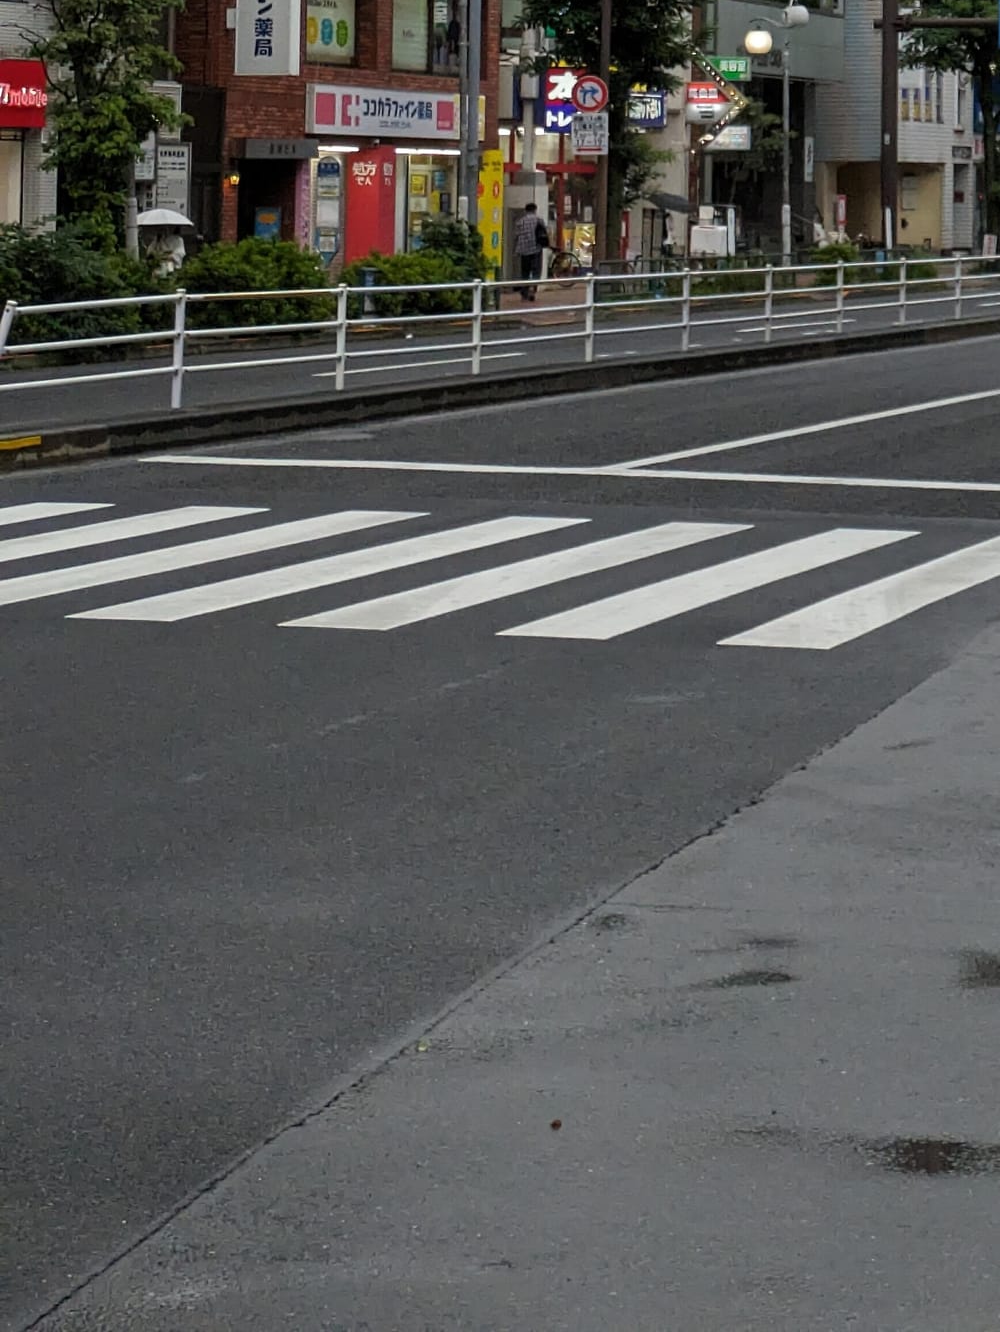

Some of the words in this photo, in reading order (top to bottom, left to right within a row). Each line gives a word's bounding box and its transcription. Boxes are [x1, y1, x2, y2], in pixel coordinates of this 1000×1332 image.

[363, 97, 433, 120] ココカラファイン薬局
[352, 160, 377, 177] 処方
[355, 176, 372, 186] せん
